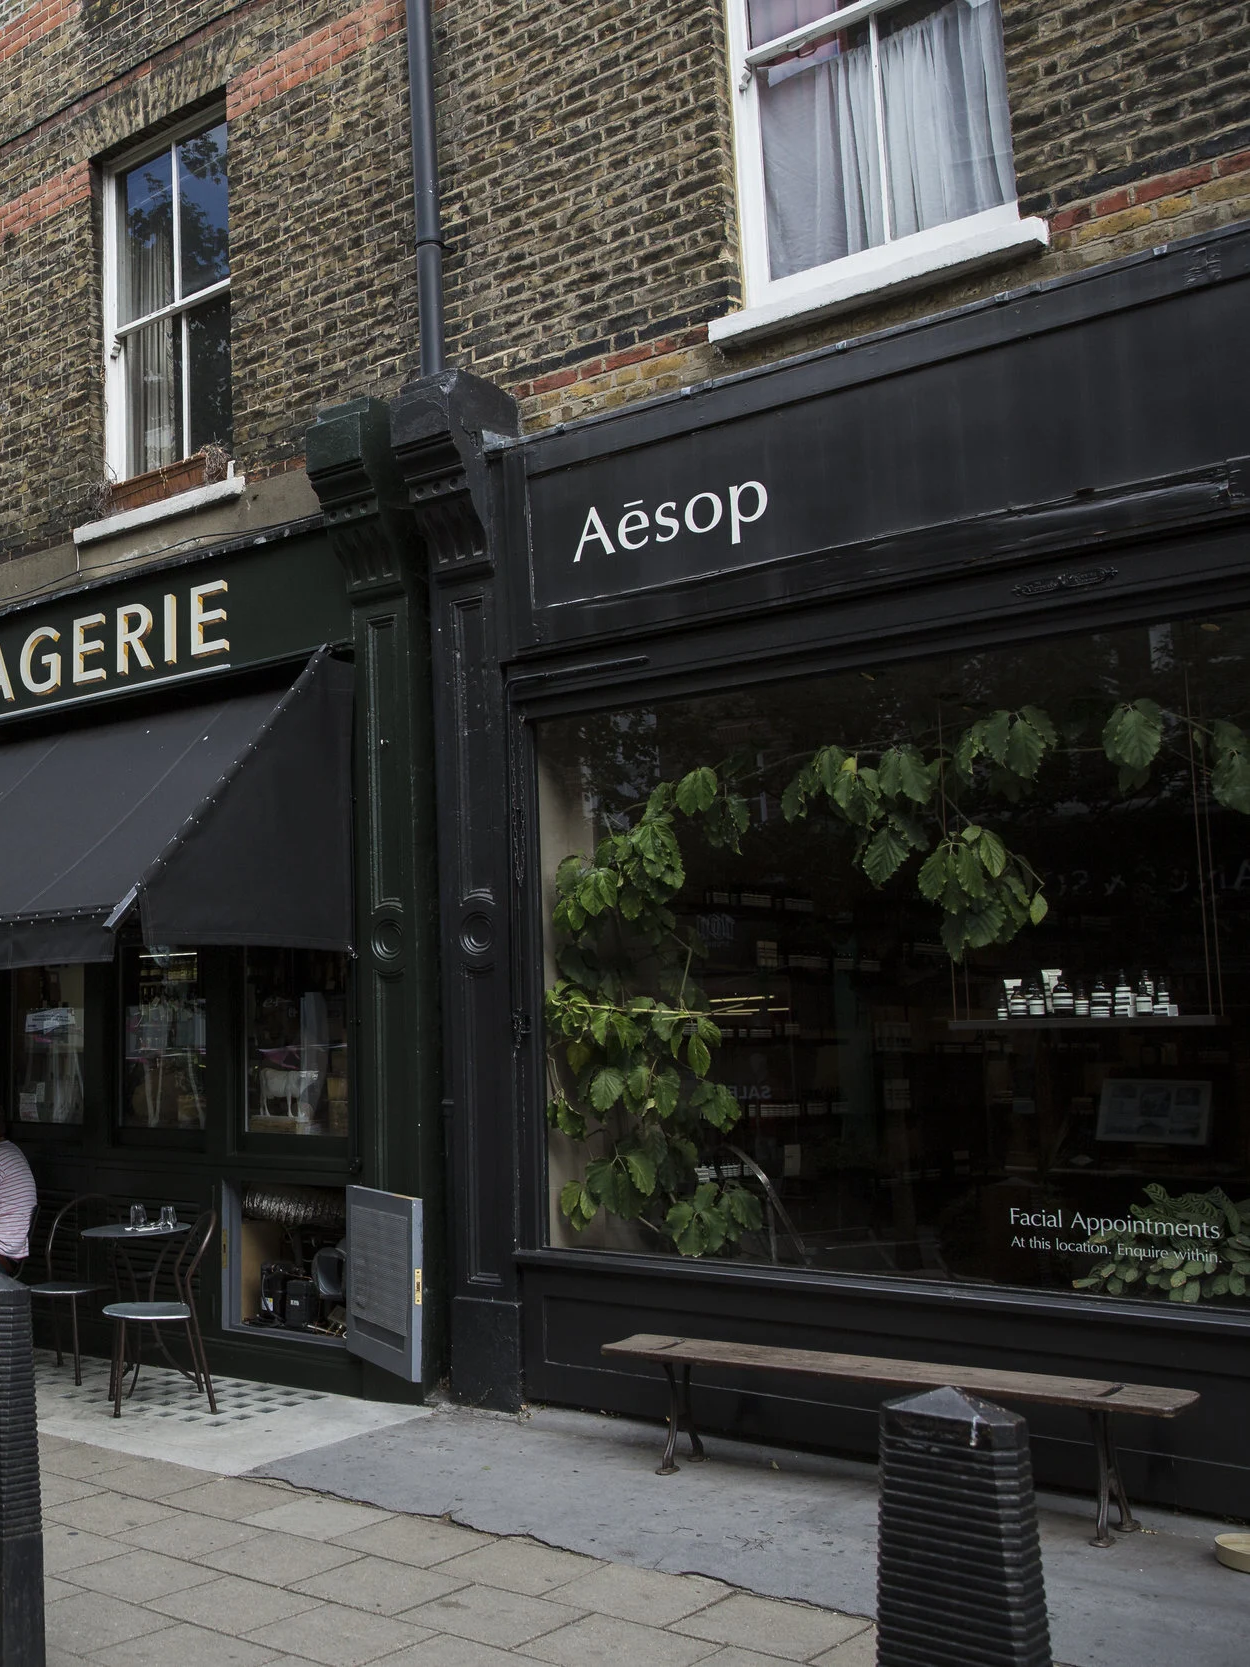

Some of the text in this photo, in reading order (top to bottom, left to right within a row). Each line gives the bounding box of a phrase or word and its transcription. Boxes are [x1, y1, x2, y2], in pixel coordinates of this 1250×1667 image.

[573, 480, 768, 563] Aēsop
[1010, 1207, 1221, 1239] Facial Appointments
[1011, 1236, 1223, 1264] At this location. Enquire within.
